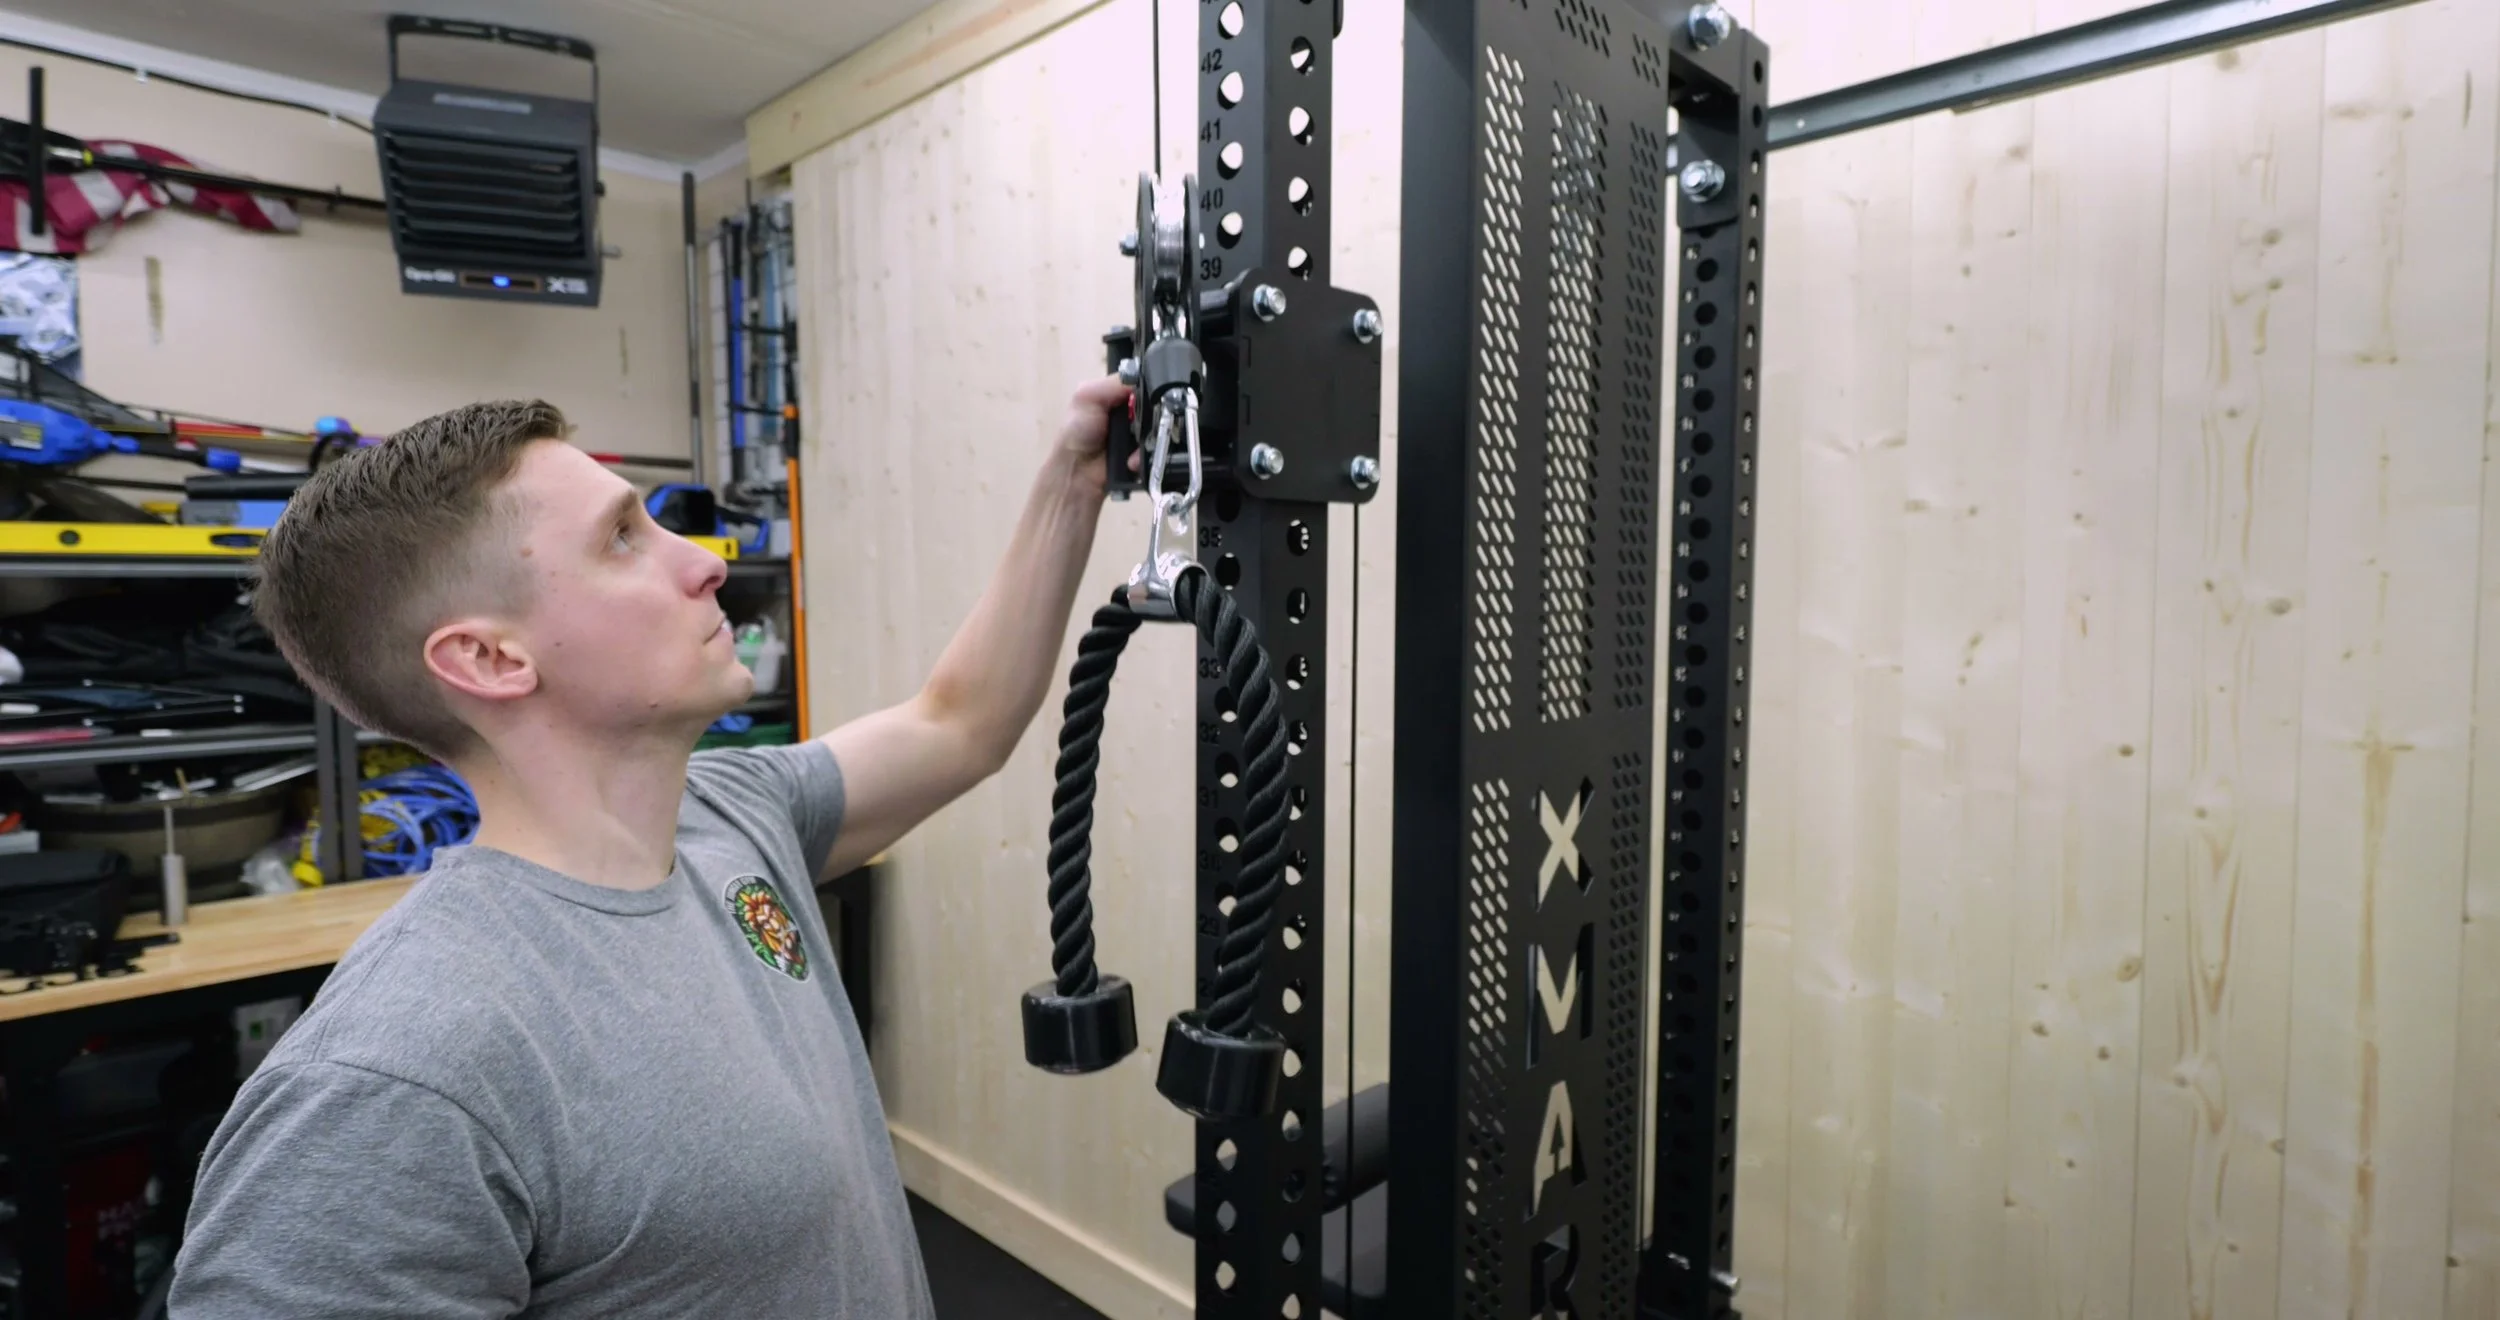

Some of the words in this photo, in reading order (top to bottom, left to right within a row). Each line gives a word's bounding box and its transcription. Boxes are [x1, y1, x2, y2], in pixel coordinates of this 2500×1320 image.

[1200, 48, 1222, 74] 42
[1200, 118, 1221, 143] 41
[1200, 188, 1223, 212] 40
[1200, 257, 1222, 281] 39
[1200, 526, 1222, 548] 35
[1200, 657, 1221, 679] 33
